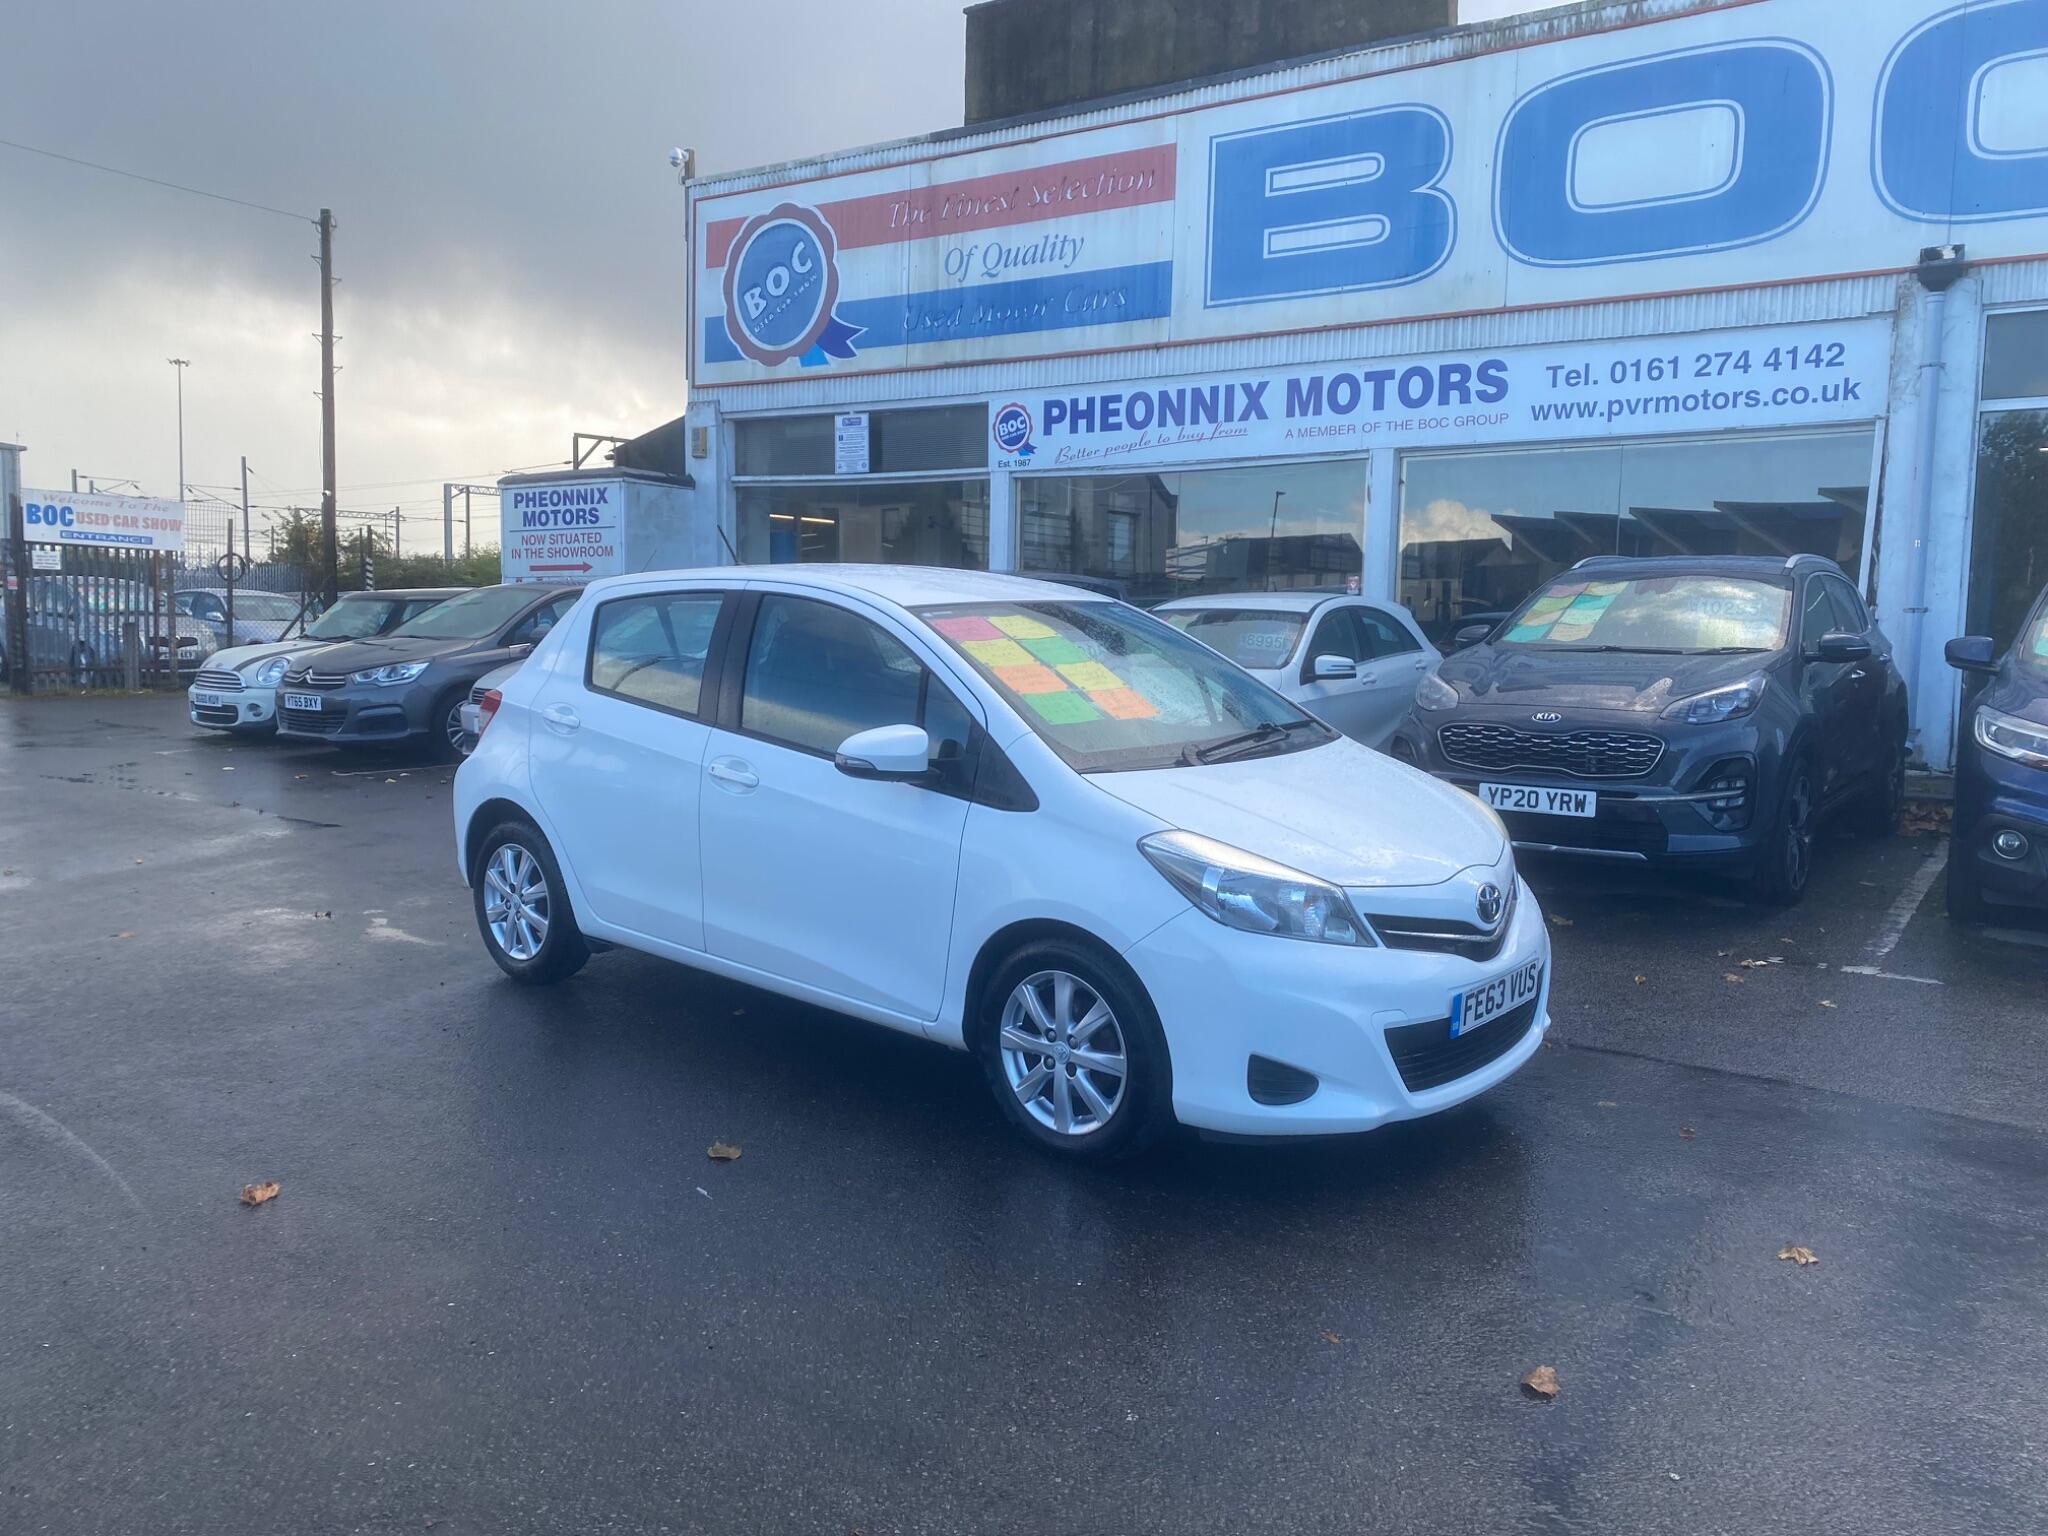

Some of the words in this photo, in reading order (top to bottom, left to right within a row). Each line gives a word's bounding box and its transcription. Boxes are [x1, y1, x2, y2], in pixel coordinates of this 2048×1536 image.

[944, 244, 979, 283] Of
[980, 233, 1085, 279] Quality
[743, 240, 813, 320] BOC
[1063, 284, 1129, 314] Cars
[1546, 361, 1598, 389] Tel.
[1609, 356, 1680, 384] 0161
[1694, 350, 1752, 378] 274
[1762, 341, 1846, 372] 4142
[1042, 380, 1271, 437] PHEONNIX
[1284, 359, 1510, 419] MOTORS
[1530, 377, 1862, 423] www.pvrmotors.co.uk
[999, 415, 1026, 436] BOC
[1285, 428, 1294, 439] A
[1297, 424, 1356, 439] MEMBER
[1361, 421, 1382, 434] OF
[1386, 418, 1414, 432] THE
[1418, 416, 1450, 430] BOC
[1454, 413, 1510, 428] GROUP
[1054, 446, 1100, 465] Better
[1104, 431, 1151, 459] people
[1157, 433, 1171, 445] to
[1177, 426, 1204, 443] buy
[1210, 420, 1249, 441] from
[998, 459, 1012, 468] Est.
[1014, 458, 1031, 468] 1987
[513, 487, 608, 509] PHEONNIX
[26, 503, 75, 527] BOC
[75, 511, 110, 527] USED
[112, 516, 139, 530] CAR
[142, 517, 182, 531] SHOW
[522, 507, 600, 527] MOTORS
[61, 531, 152, 544] ENTRANCE
[521, 534, 546, 546] NOW
[548, 532, 602, 546] SITUATED
[511, 548, 521, 559] IN
[524, 547, 544, 559] THE
[547, 545, 614, 559] SHOWROOM
[1535, 712, 1556, 721] KIA
[1488, 786, 1540, 809] YP20
[1546, 791, 1587, 814] YRW
[1463, 978, 1506, 1027] FE63
[1510, 963, 1537, 1002] VUS
